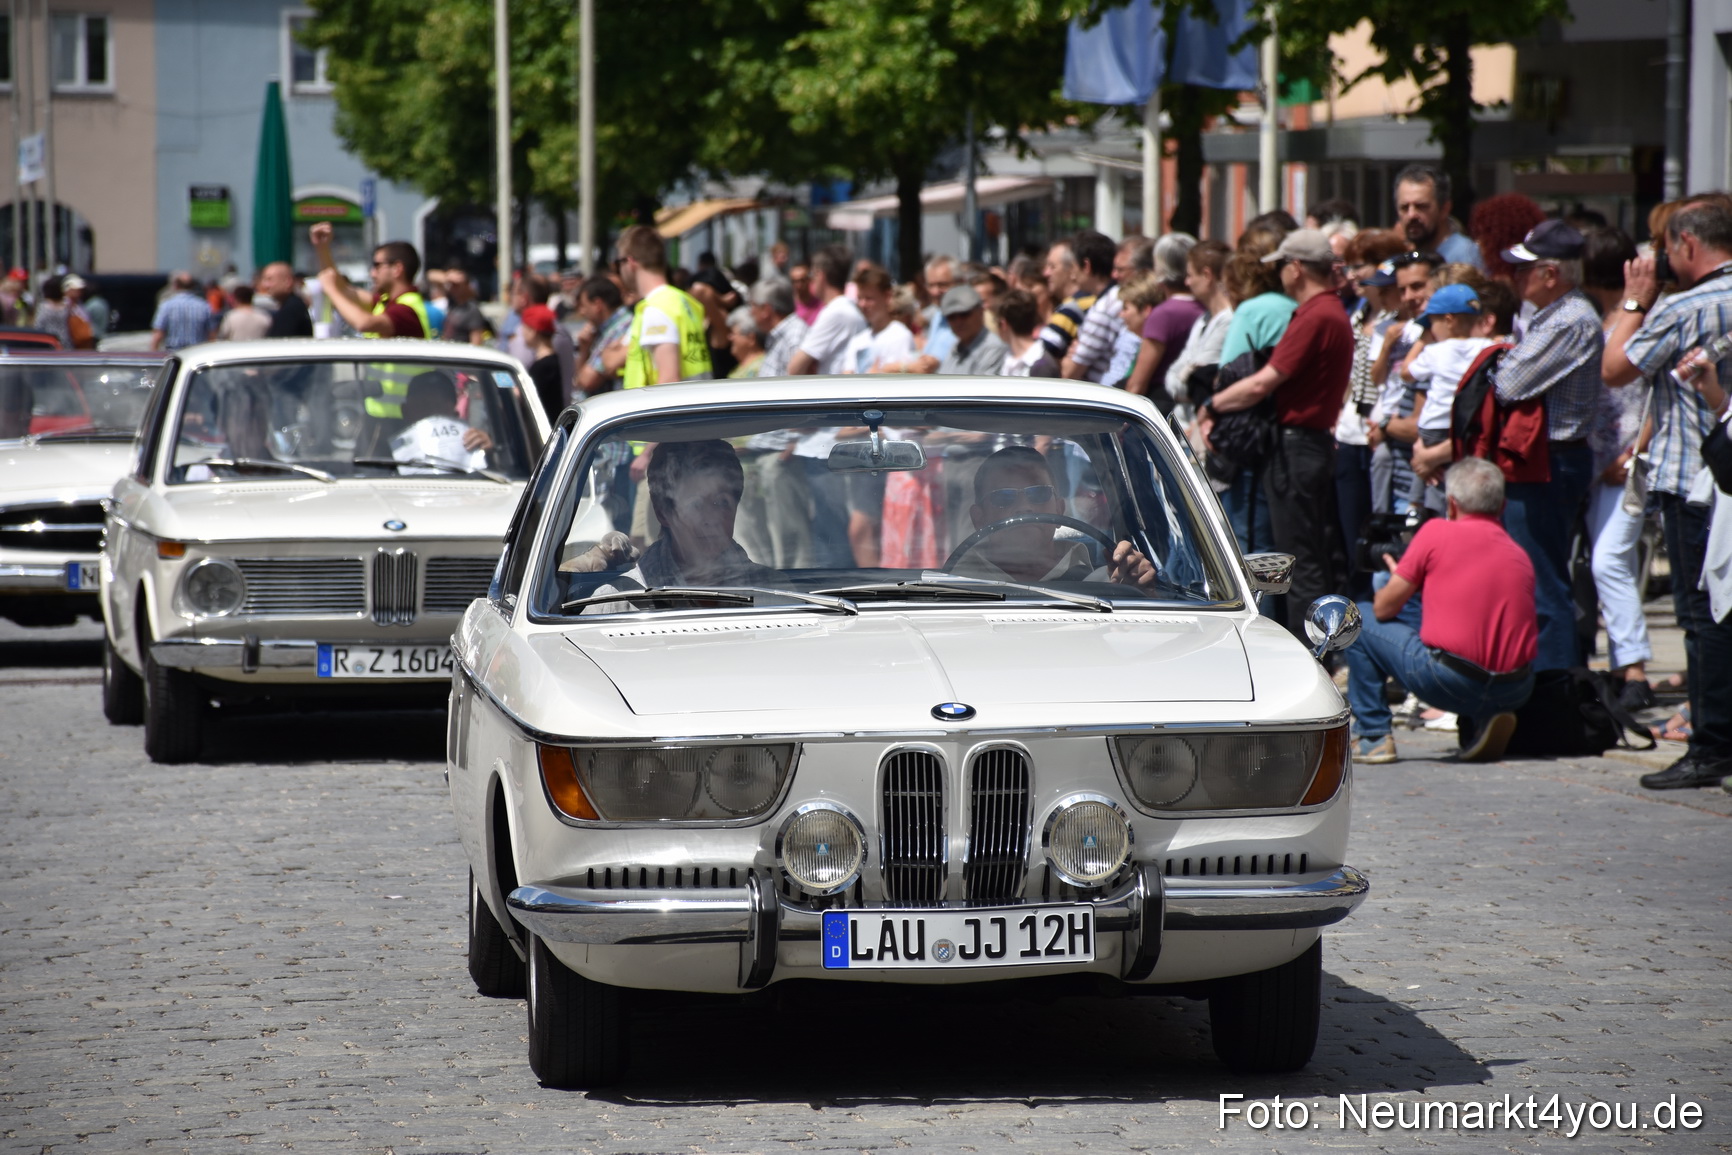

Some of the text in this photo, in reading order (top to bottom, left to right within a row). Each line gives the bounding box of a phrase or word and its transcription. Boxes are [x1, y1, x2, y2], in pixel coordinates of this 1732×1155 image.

[334, 648, 349, 673] R
[369, 648, 384, 673] Z
[850, 912, 1091, 961] LAU JJ 12H
[831, 945, 841, 958] D
